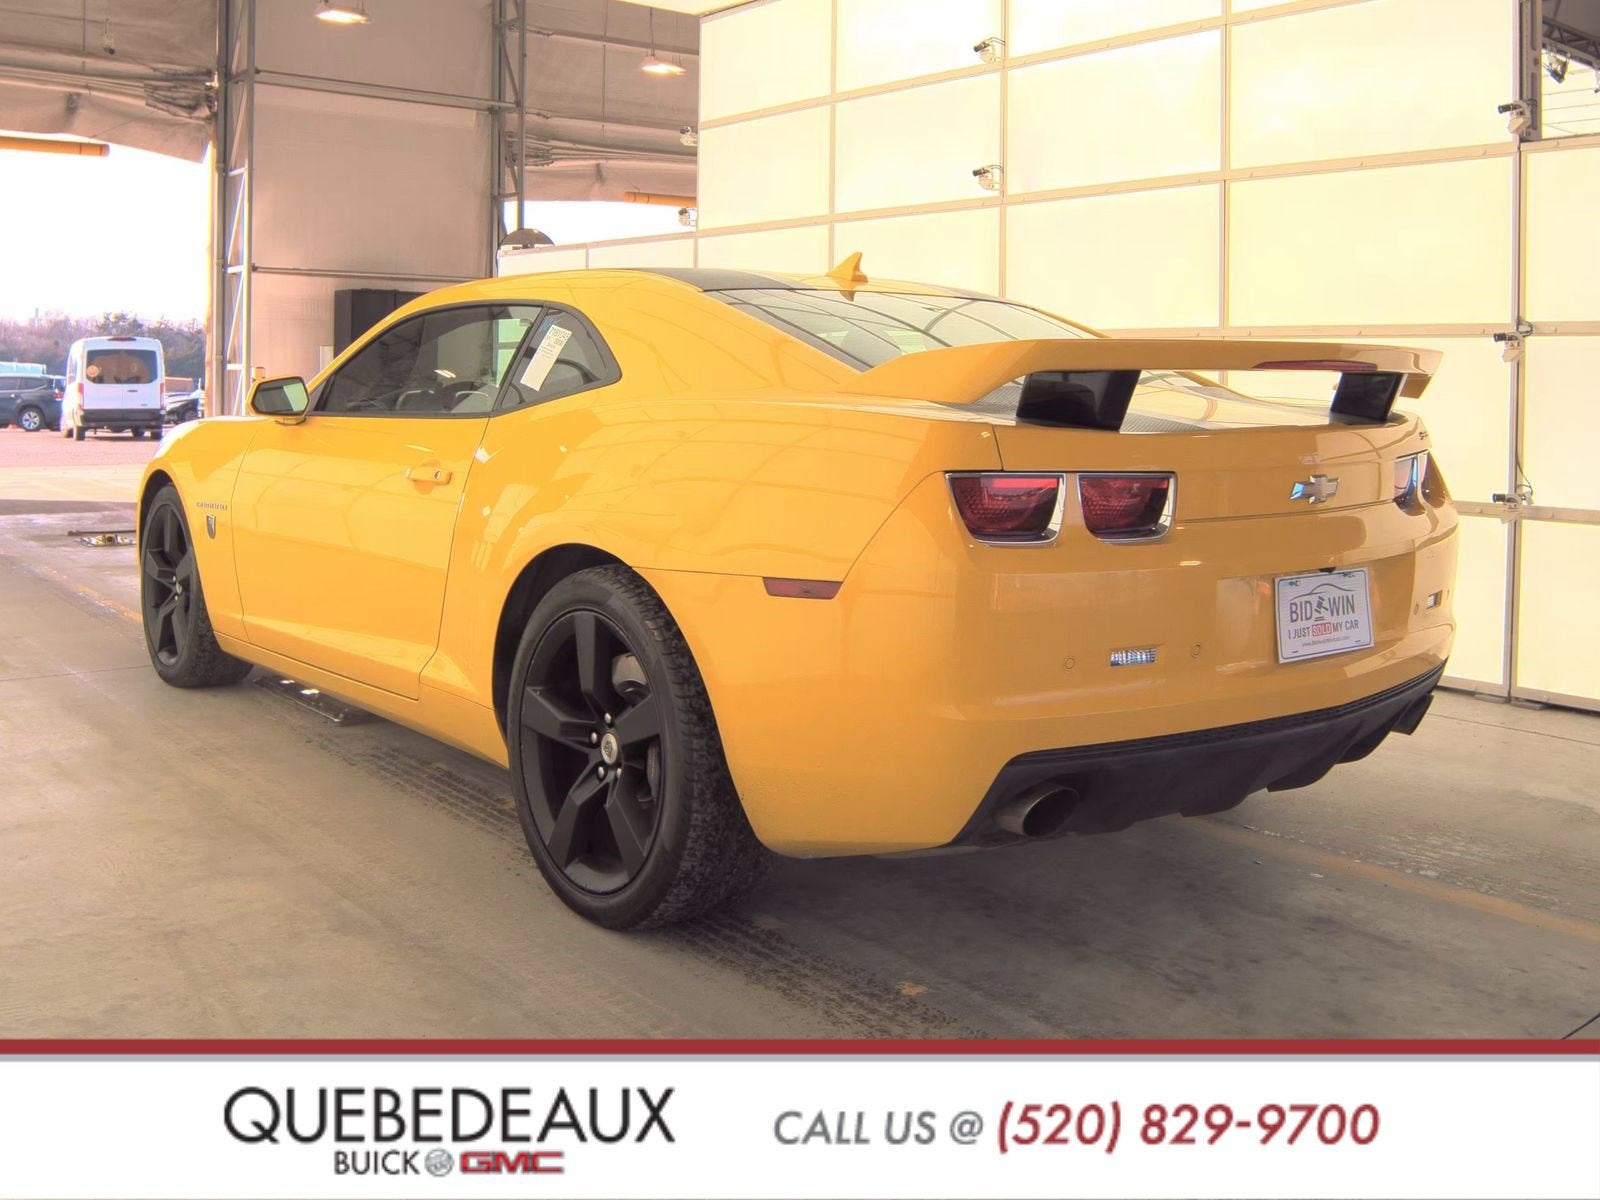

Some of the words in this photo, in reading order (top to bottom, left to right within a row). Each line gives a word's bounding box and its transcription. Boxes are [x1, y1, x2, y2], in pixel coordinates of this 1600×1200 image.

[1289, 600, 1313, 623] BID
[1328, 594, 1355, 617] WIN
[1292, 626, 1310, 640] JUST
[1312, 622, 1332, 637] SOLD
[1332, 622, 1343, 633] MY
[1345, 619, 1360, 631] CAR
